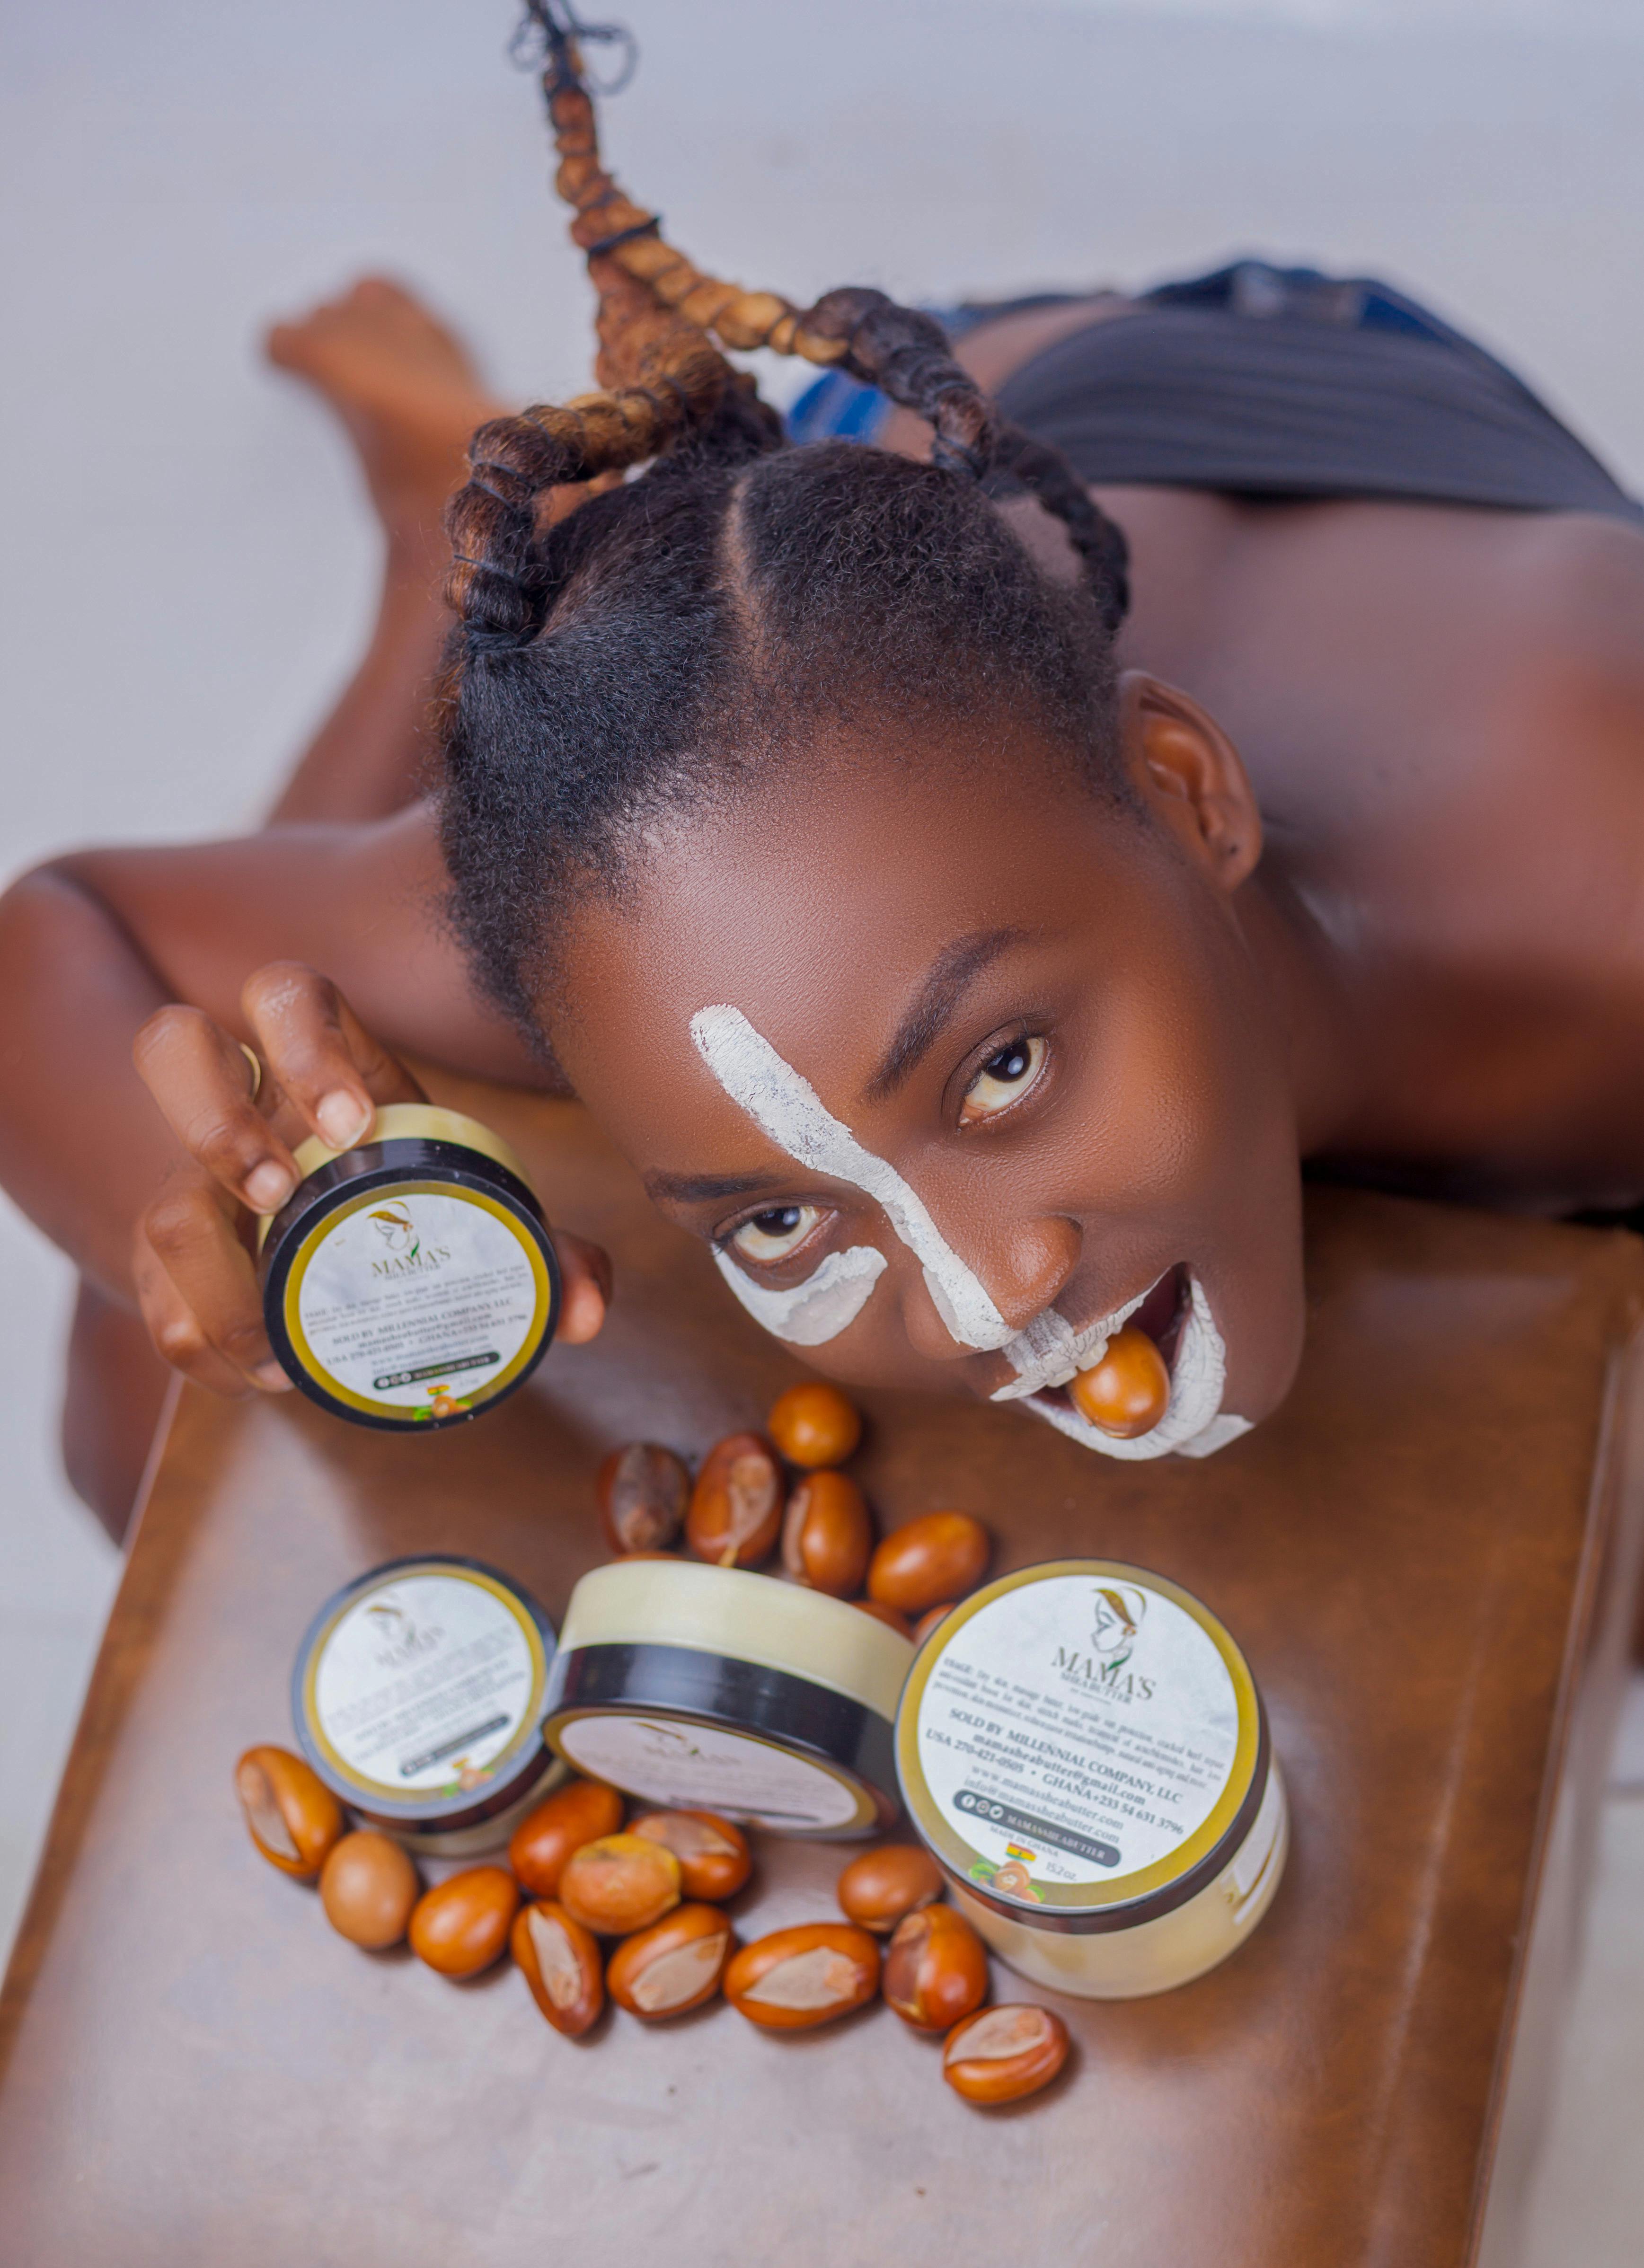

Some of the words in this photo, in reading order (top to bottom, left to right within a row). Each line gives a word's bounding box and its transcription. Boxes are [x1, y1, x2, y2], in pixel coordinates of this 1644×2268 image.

[1051, 1645, 1157, 1702] MAMA'S
[925, 1728, 954, 1747] USA
[948, 1707, 986, 1729] SOLD
[985, 1721, 1004, 1736] BY
[1007, 1729, 1086, 1767] MILLENNIAL
[1156, 1785, 1184, 1804] LLC
